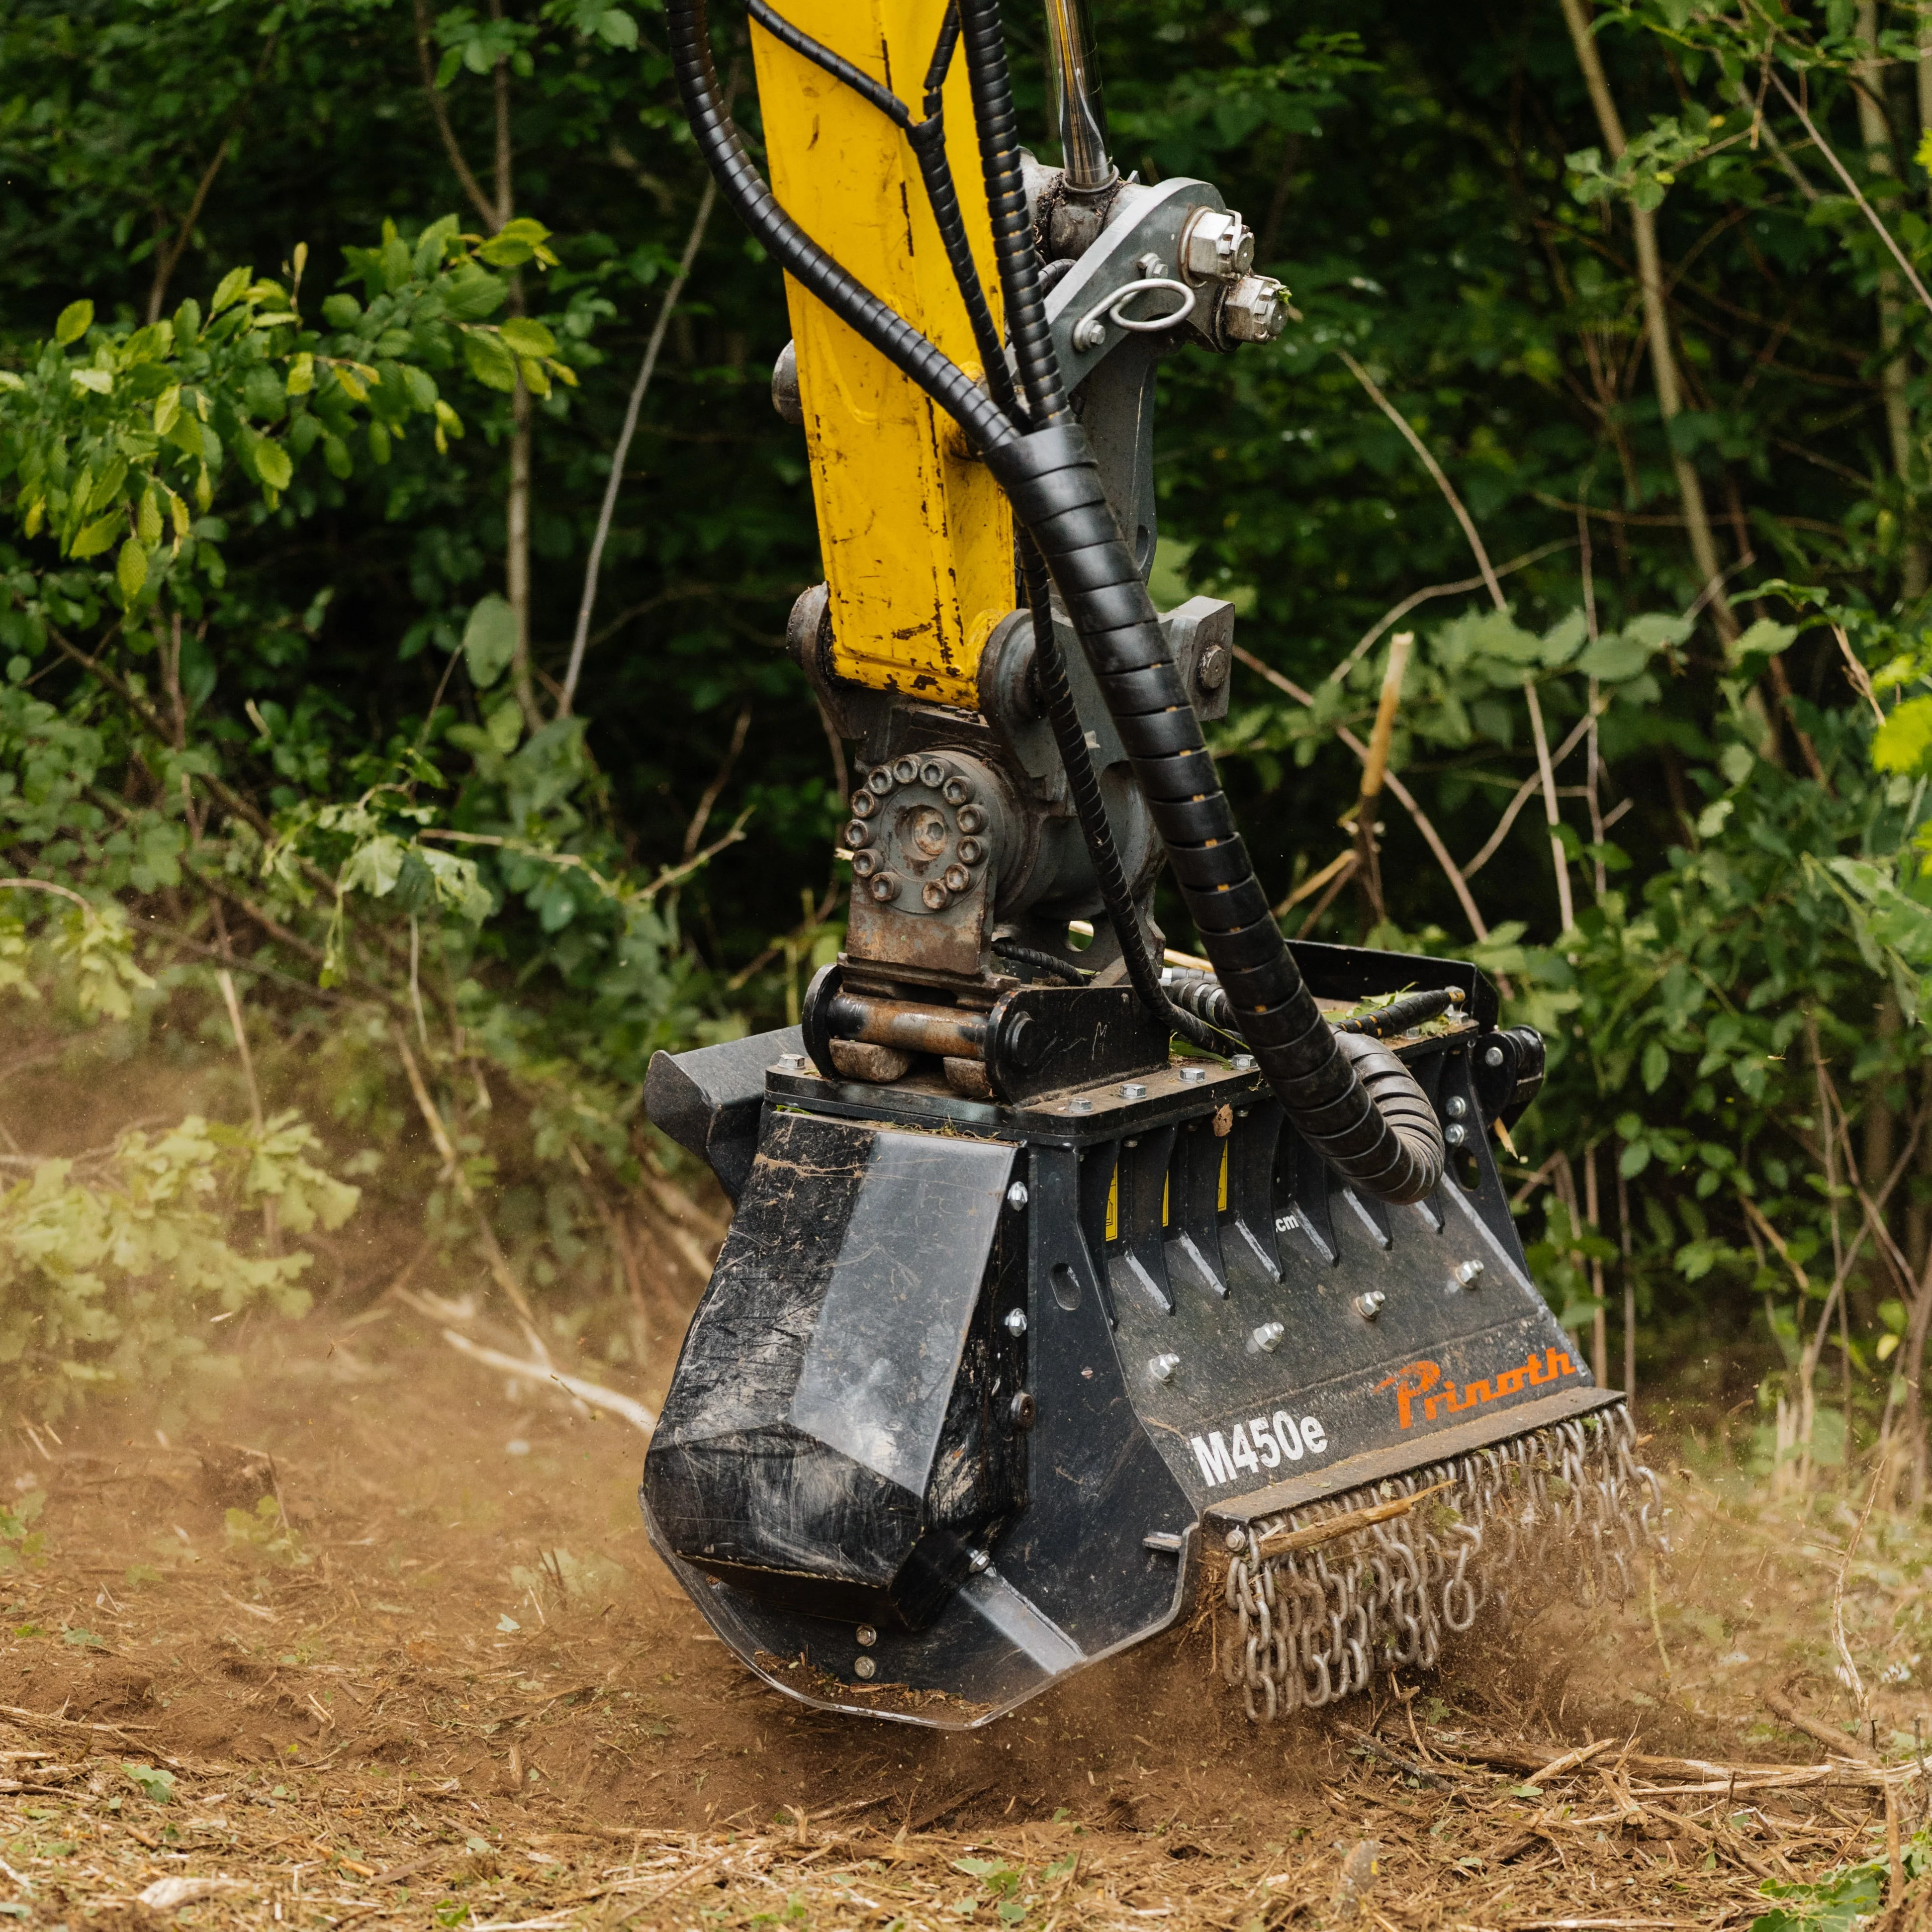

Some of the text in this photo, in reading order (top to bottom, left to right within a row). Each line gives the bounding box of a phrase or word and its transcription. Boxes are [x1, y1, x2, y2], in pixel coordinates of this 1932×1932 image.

[1276, 1215, 1299, 1233] cm
[1374, 1347, 1576, 1430] Prinoth
[1190, 1410, 1328, 1487] M450e
